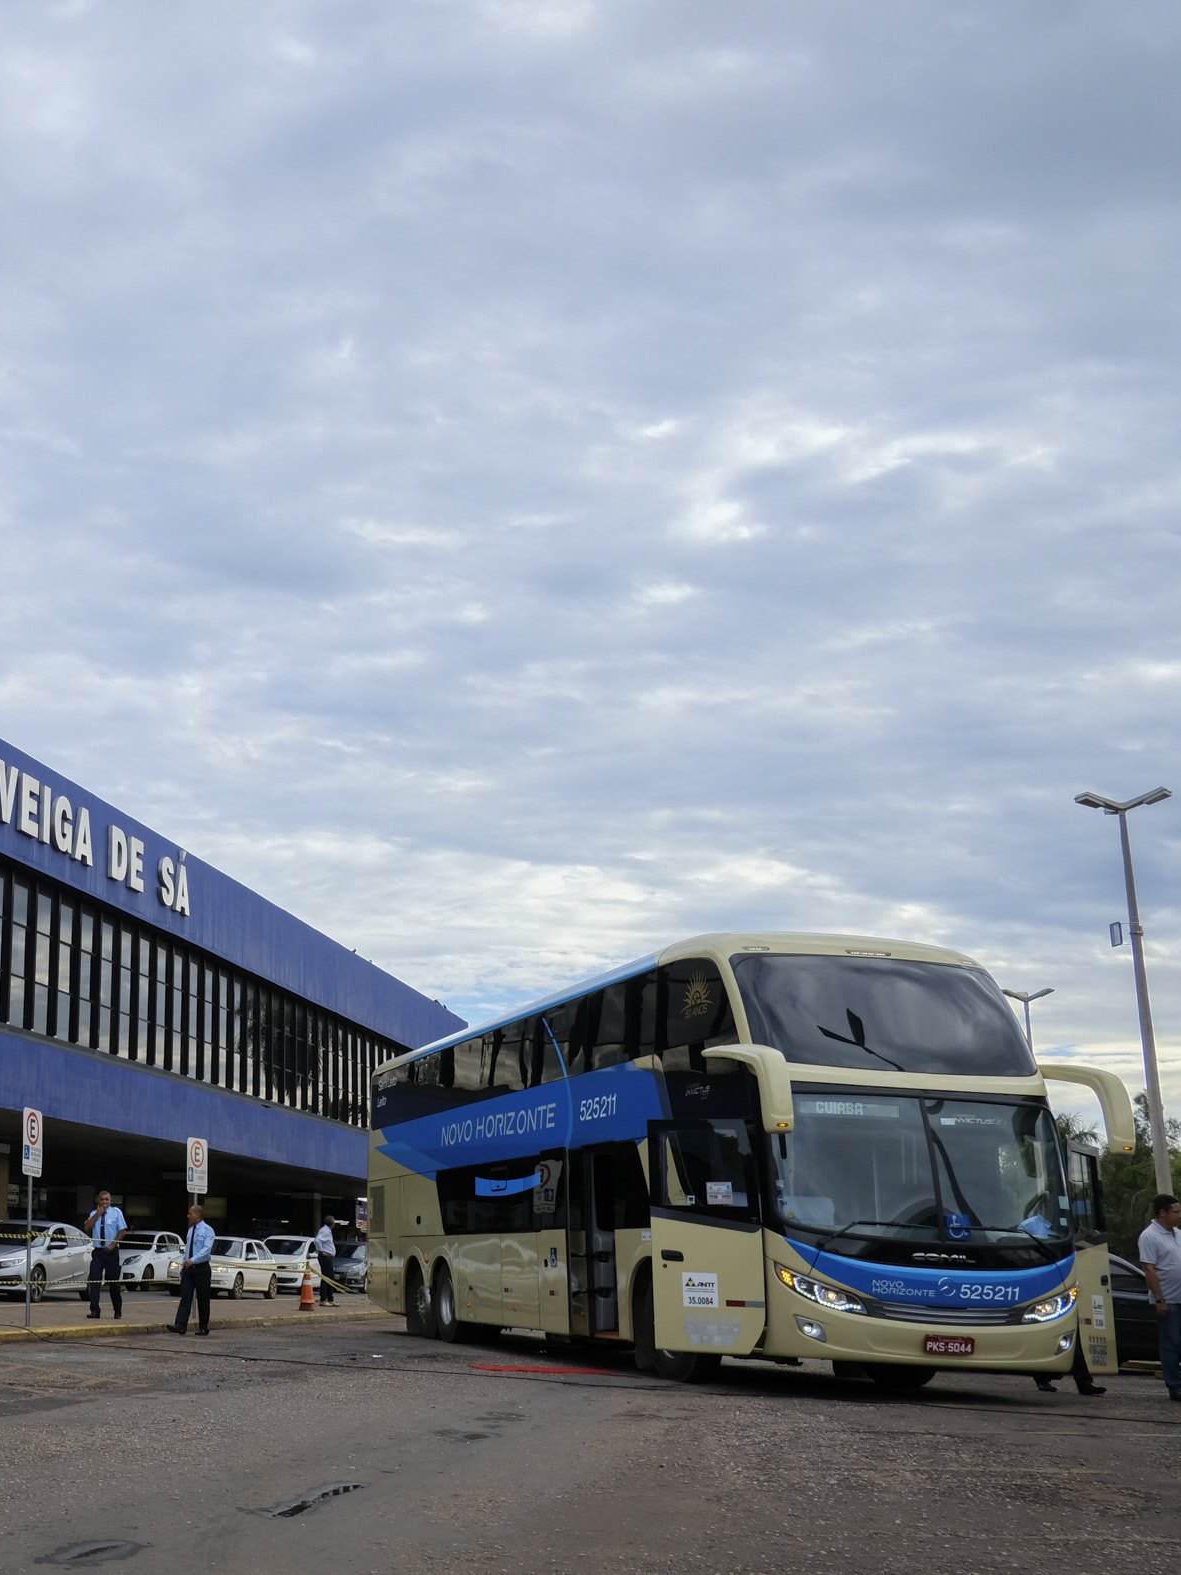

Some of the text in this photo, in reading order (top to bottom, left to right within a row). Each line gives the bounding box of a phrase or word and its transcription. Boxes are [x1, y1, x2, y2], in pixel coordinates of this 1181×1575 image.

[107, 824, 144, 893] DE
[157, 849, 191, 907] SÁ
[579, 1092, 618, 1122] 525211
[815, 1100, 864, 1116] CUIABA
[30, 1118, 36, 1139] E
[440, 1102, 557, 1147] NOVO HORIZONTE
[194, 1145, 201, 1163] E
[911, 1252, 977, 1264] COMIL
[871, 1279, 904, 1288] NOVO
[871, 1286, 937, 1298] HORIZONTE
[688, 1296, 714, 1305] 35.0084
[959, 1284, 1020, 1301] 525211
